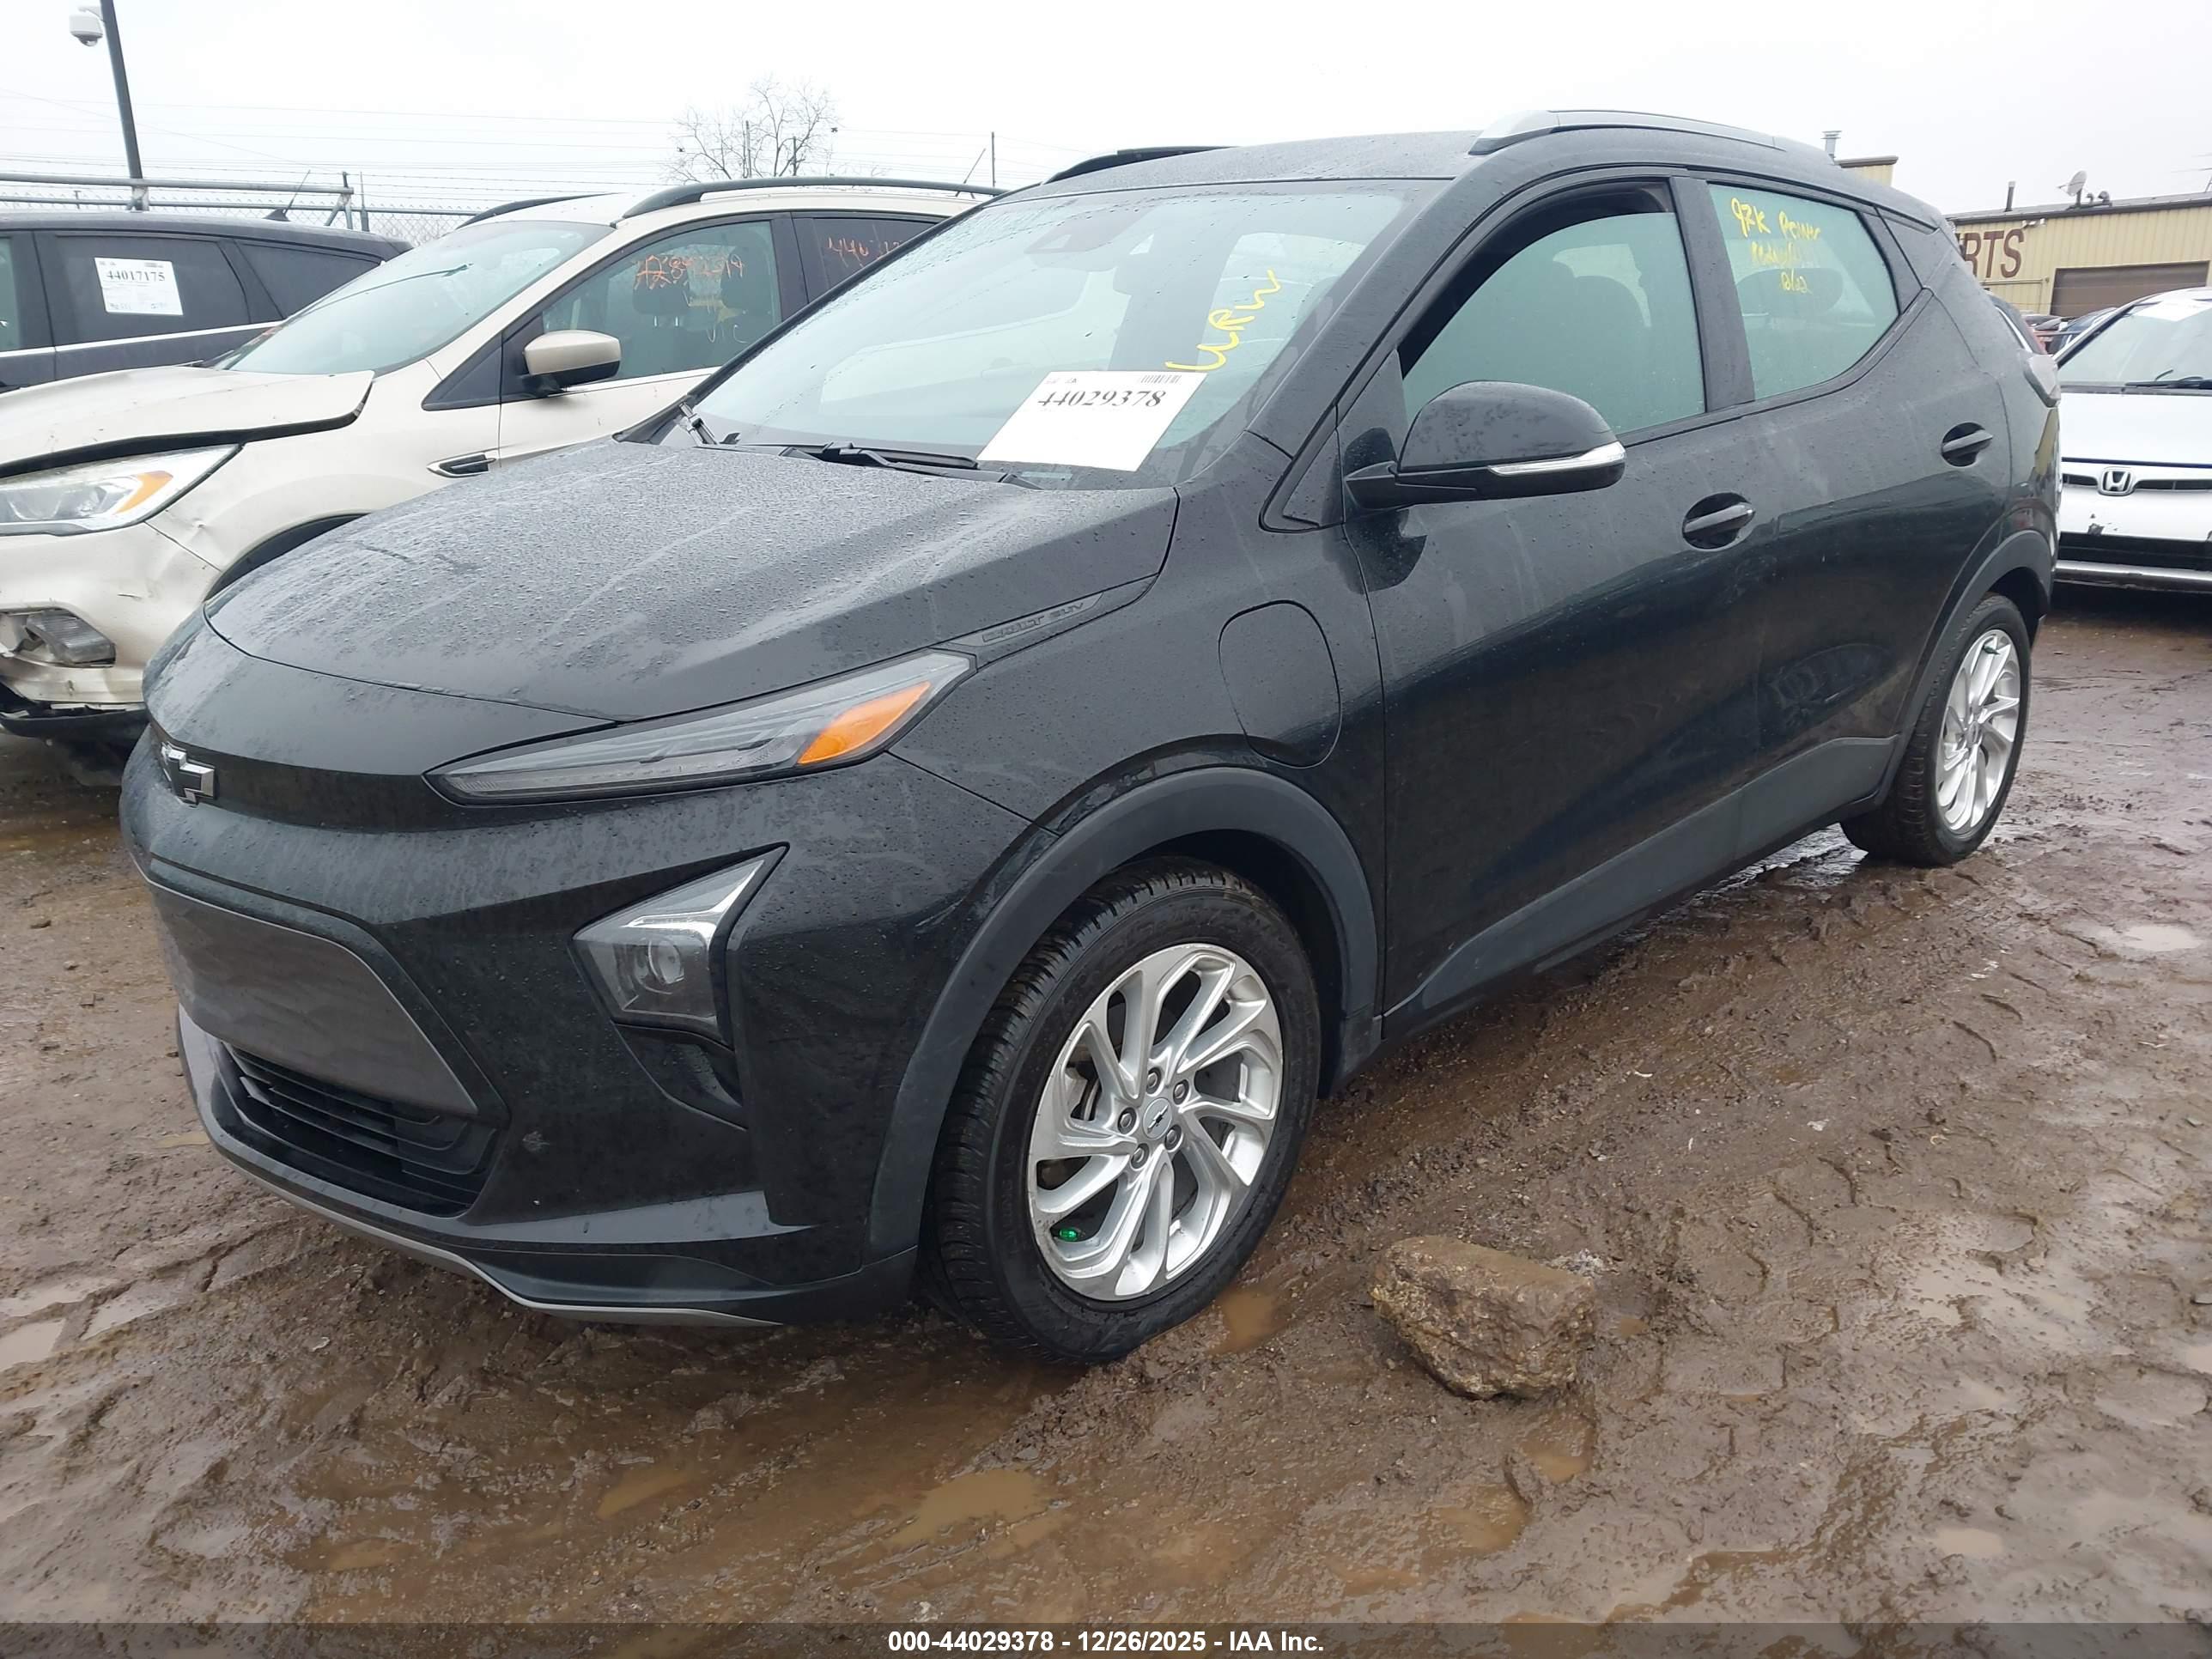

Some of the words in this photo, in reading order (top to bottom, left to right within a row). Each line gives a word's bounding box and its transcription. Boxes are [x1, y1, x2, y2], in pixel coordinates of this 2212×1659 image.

[1956, 228, 2024, 278] RTS
[106, 270, 166, 282] 44017175
[1037, 390, 1167, 408] 44029378
